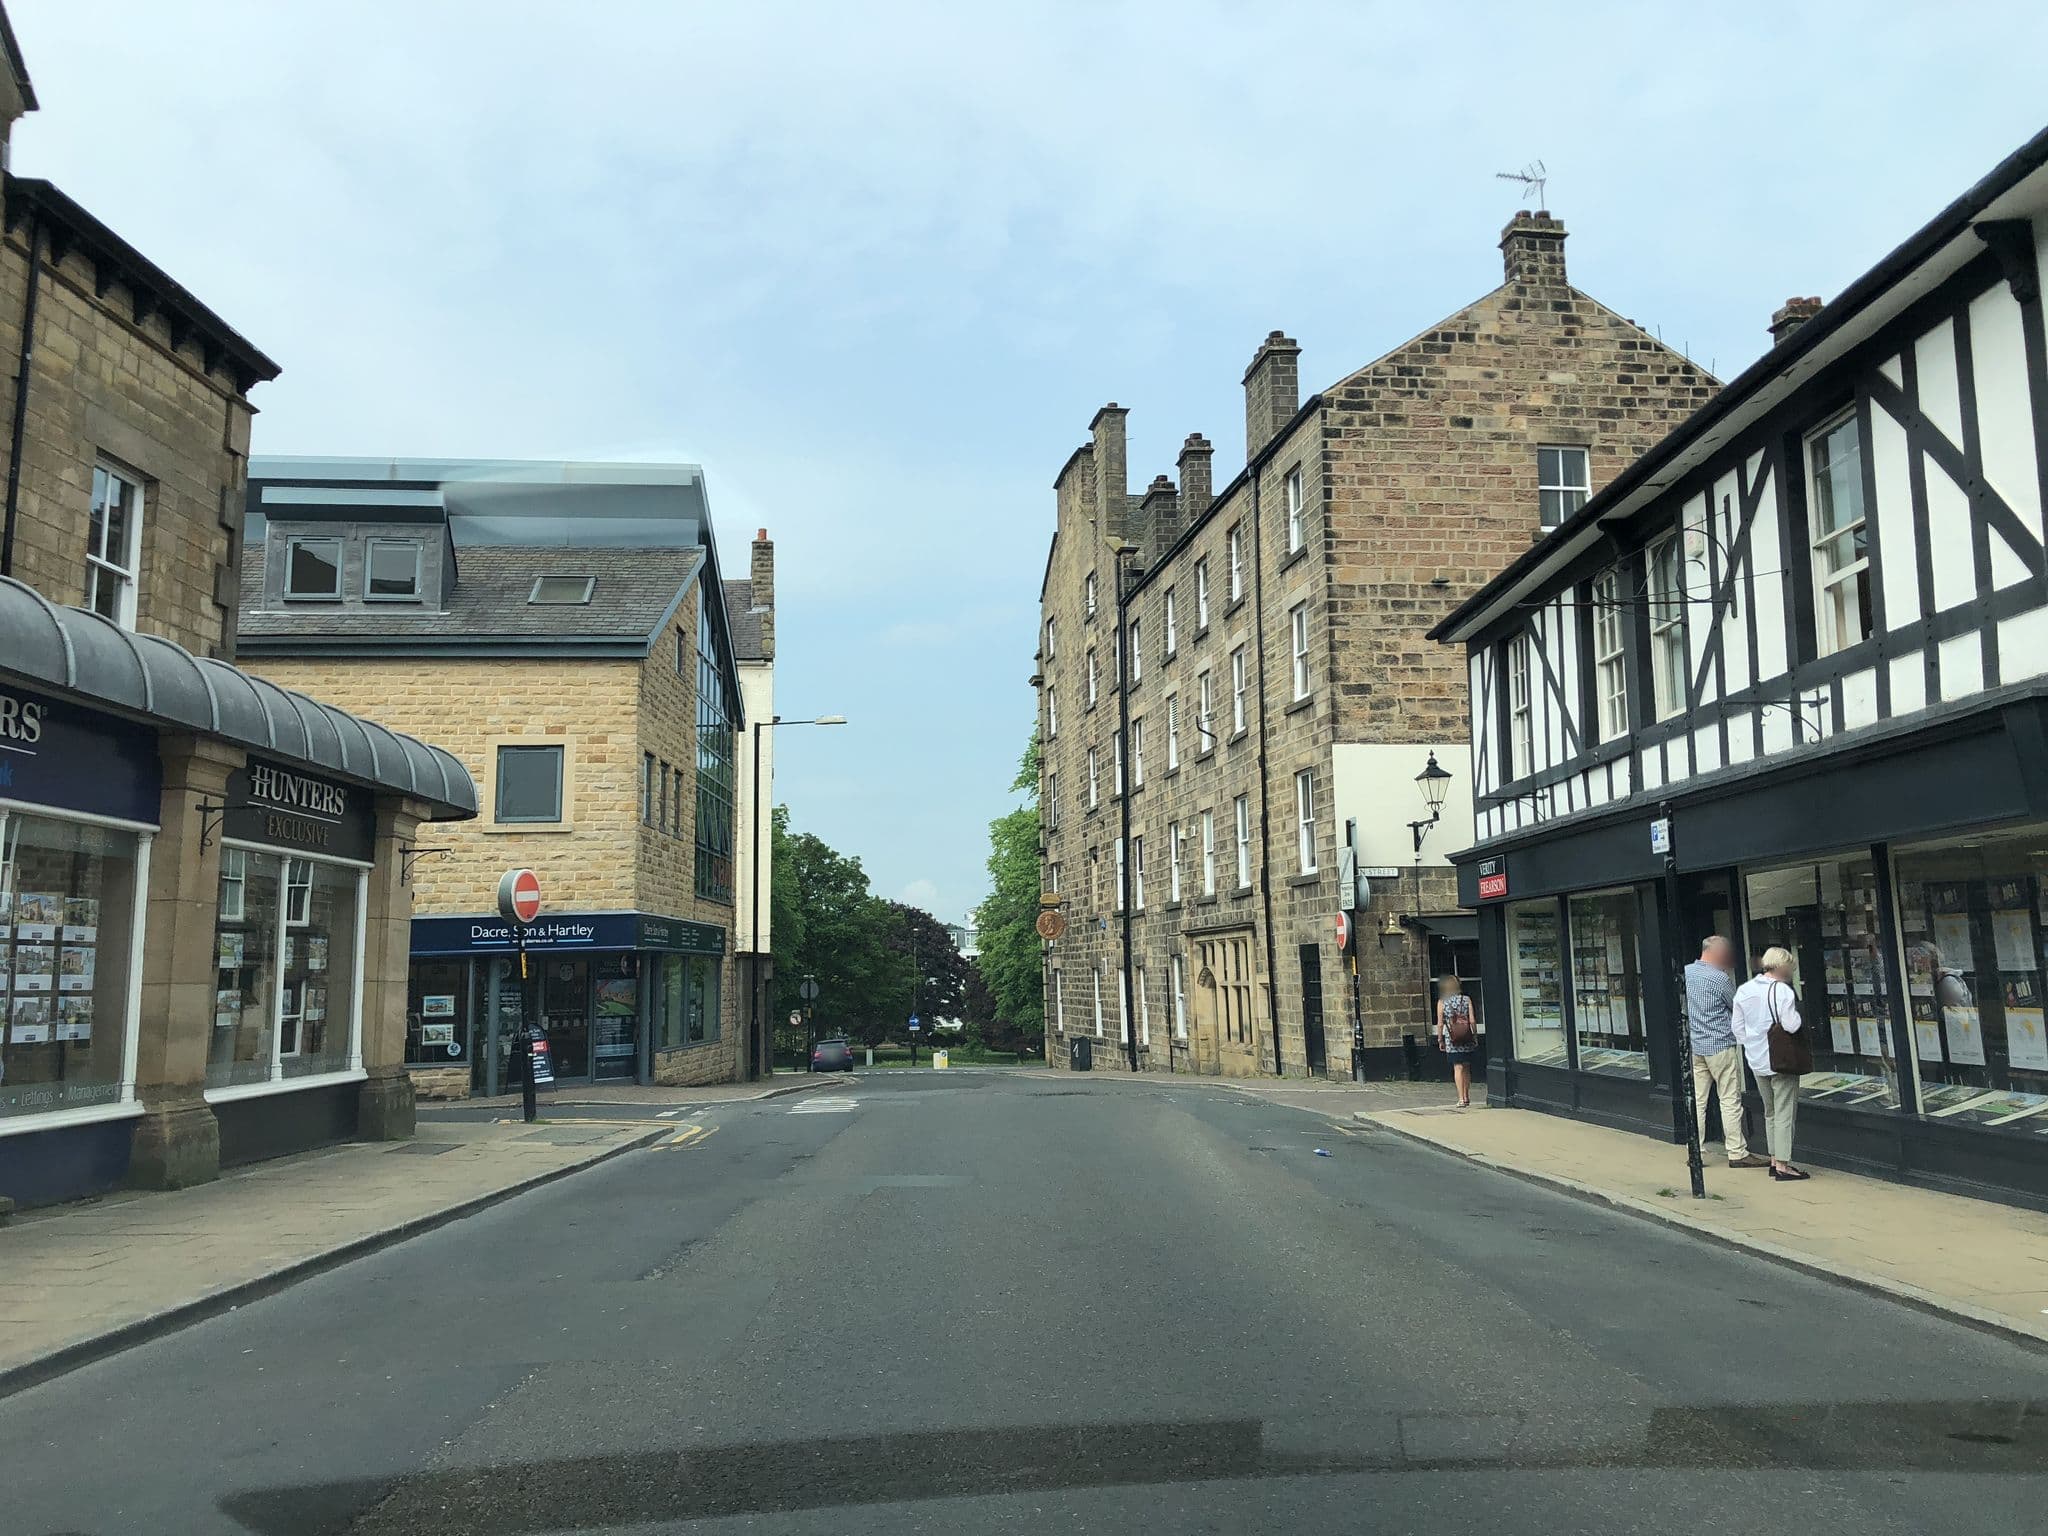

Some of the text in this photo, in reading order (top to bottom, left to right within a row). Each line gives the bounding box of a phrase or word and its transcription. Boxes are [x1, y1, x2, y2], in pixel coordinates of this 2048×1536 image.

[251, 765, 344, 815] HUNTERS
[268, 815, 328, 846] EXCLUSIVE
[1479, 861, 1496, 875] VERITY
[1480, 878, 1505, 894] FREARSON
[471, 925, 511, 938] Dacre,
[539, 927, 546, 936] &
[548, 923, 594, 938] Hartley
